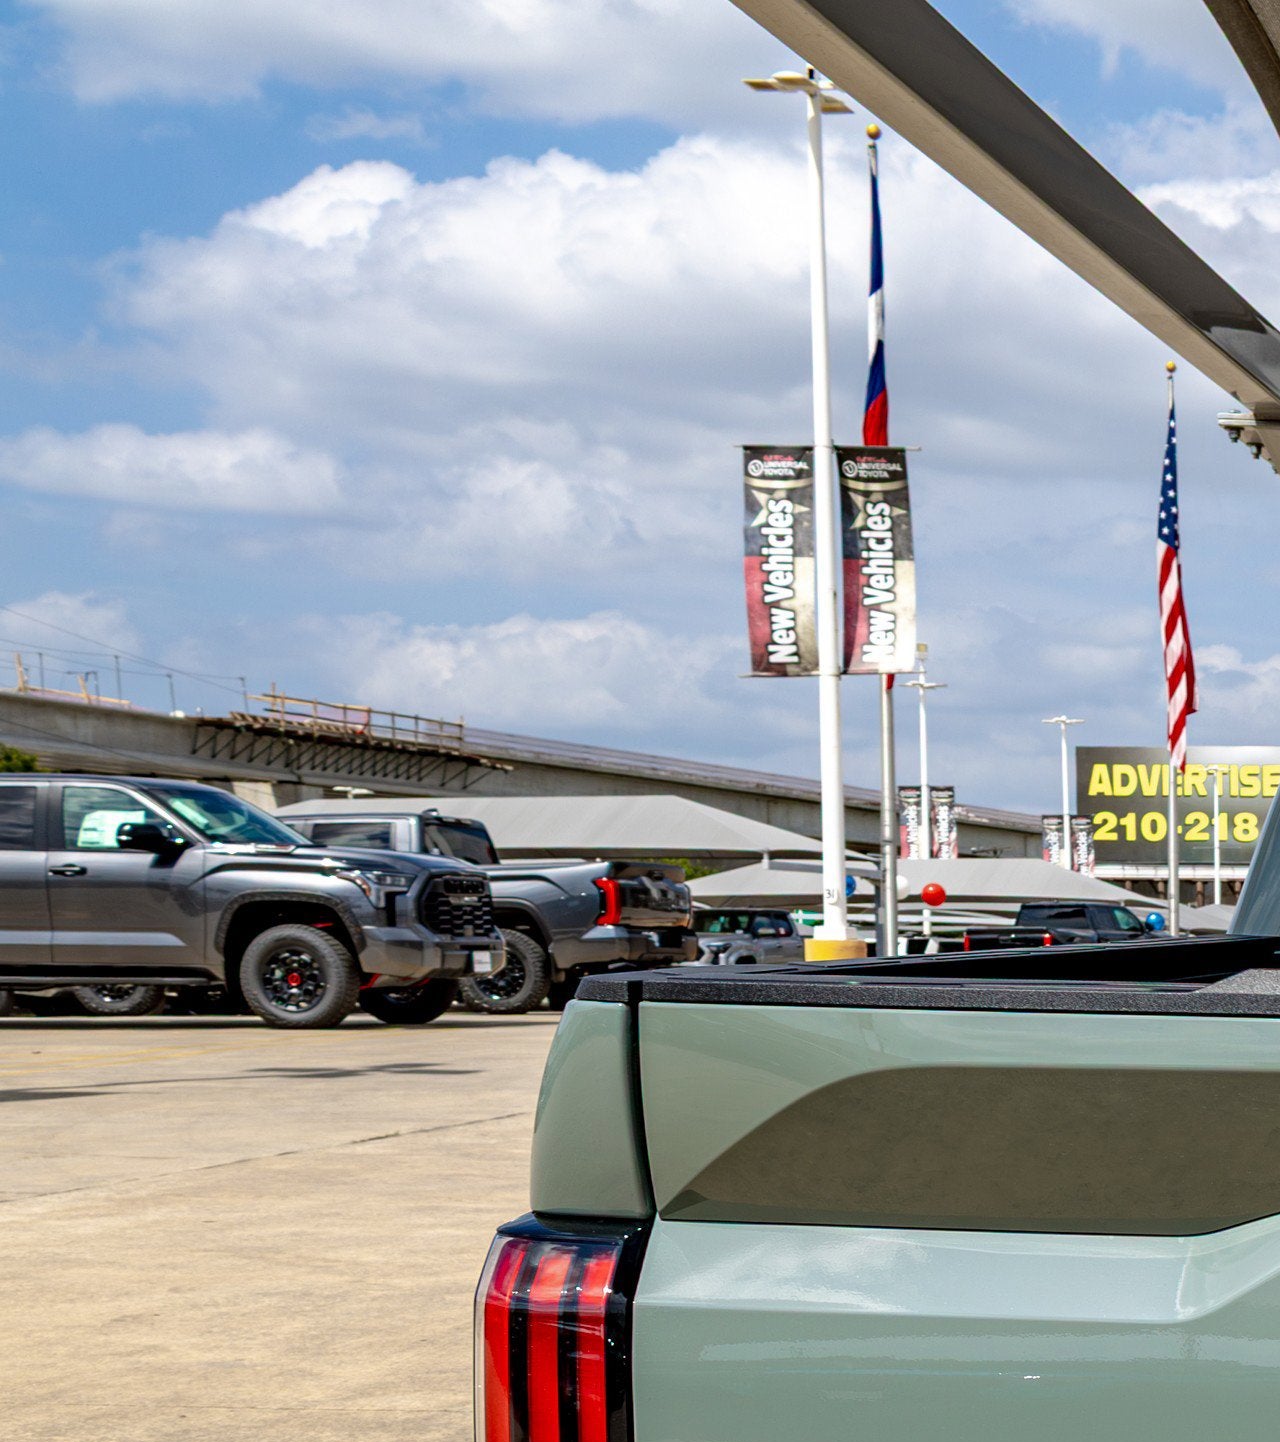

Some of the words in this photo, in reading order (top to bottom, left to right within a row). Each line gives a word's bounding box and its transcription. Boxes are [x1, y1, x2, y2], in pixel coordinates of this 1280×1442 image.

[763, 461, 809, 470] UNIVERSAL
[763, 469, 796, 477] TOYOTA
[857, 461, 903, 471] UNIVERSAL
[858, 470, 889, 478] TOYOTA
[761, 498, 794, 604] Vehicles
[860, 501, 895, 606] Vehicles
[767, 607, 799, 664] New
[862, 610, 895, 664] New
